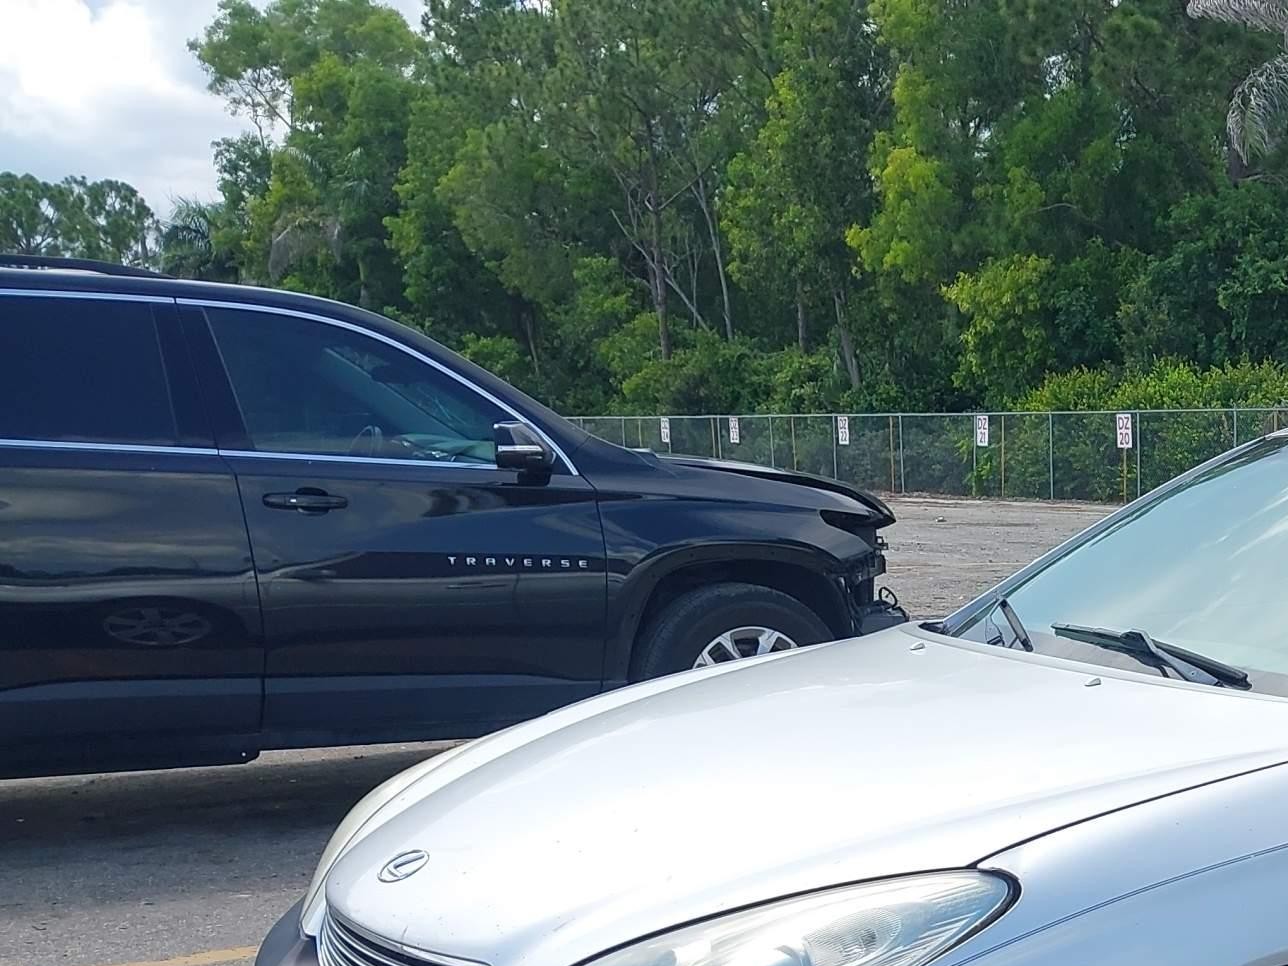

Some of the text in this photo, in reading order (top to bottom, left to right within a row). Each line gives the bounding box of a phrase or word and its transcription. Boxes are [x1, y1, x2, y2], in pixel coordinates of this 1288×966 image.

[977, 417, 987, 430] DZ
[1118, 416, 1130, 430] DZ
[840, 431, 848, 442] 22
[979, 431, 986, 443] 21
[1119, 432, 1130, 445] 20
[448, 556, 588, 568] TRAVERSE
